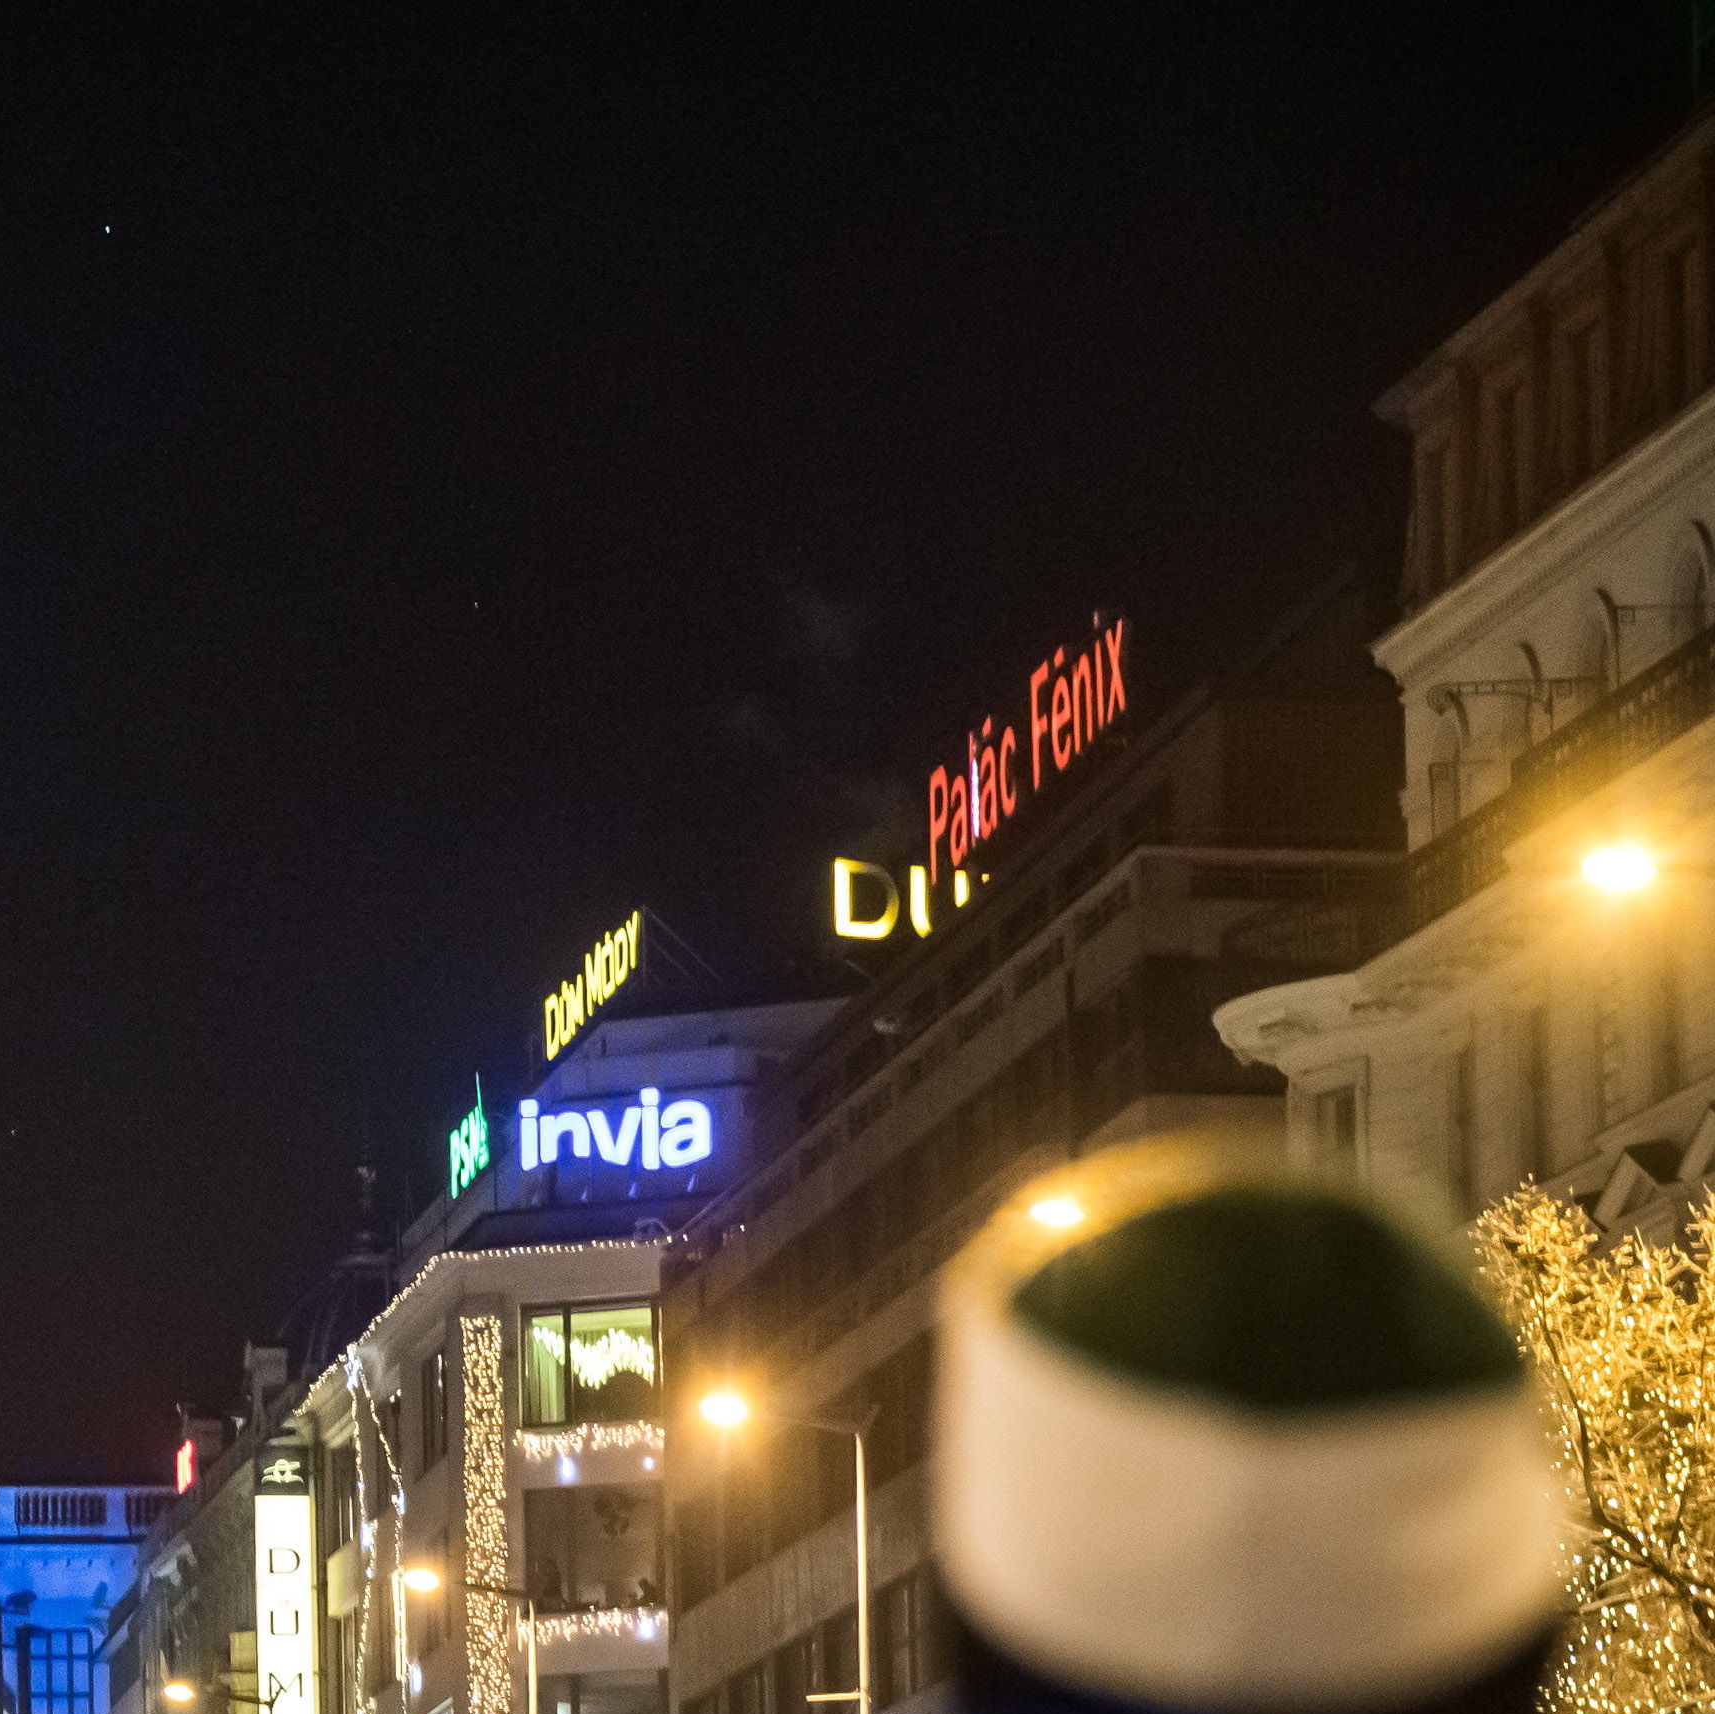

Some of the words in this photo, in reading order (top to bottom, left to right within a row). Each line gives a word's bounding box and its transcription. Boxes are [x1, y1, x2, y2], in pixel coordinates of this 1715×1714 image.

[928, 716, 1017, 885] Palác
[1030, 611, 1125, 790] Fénix
[520, 1087, 712, 1171] invia
